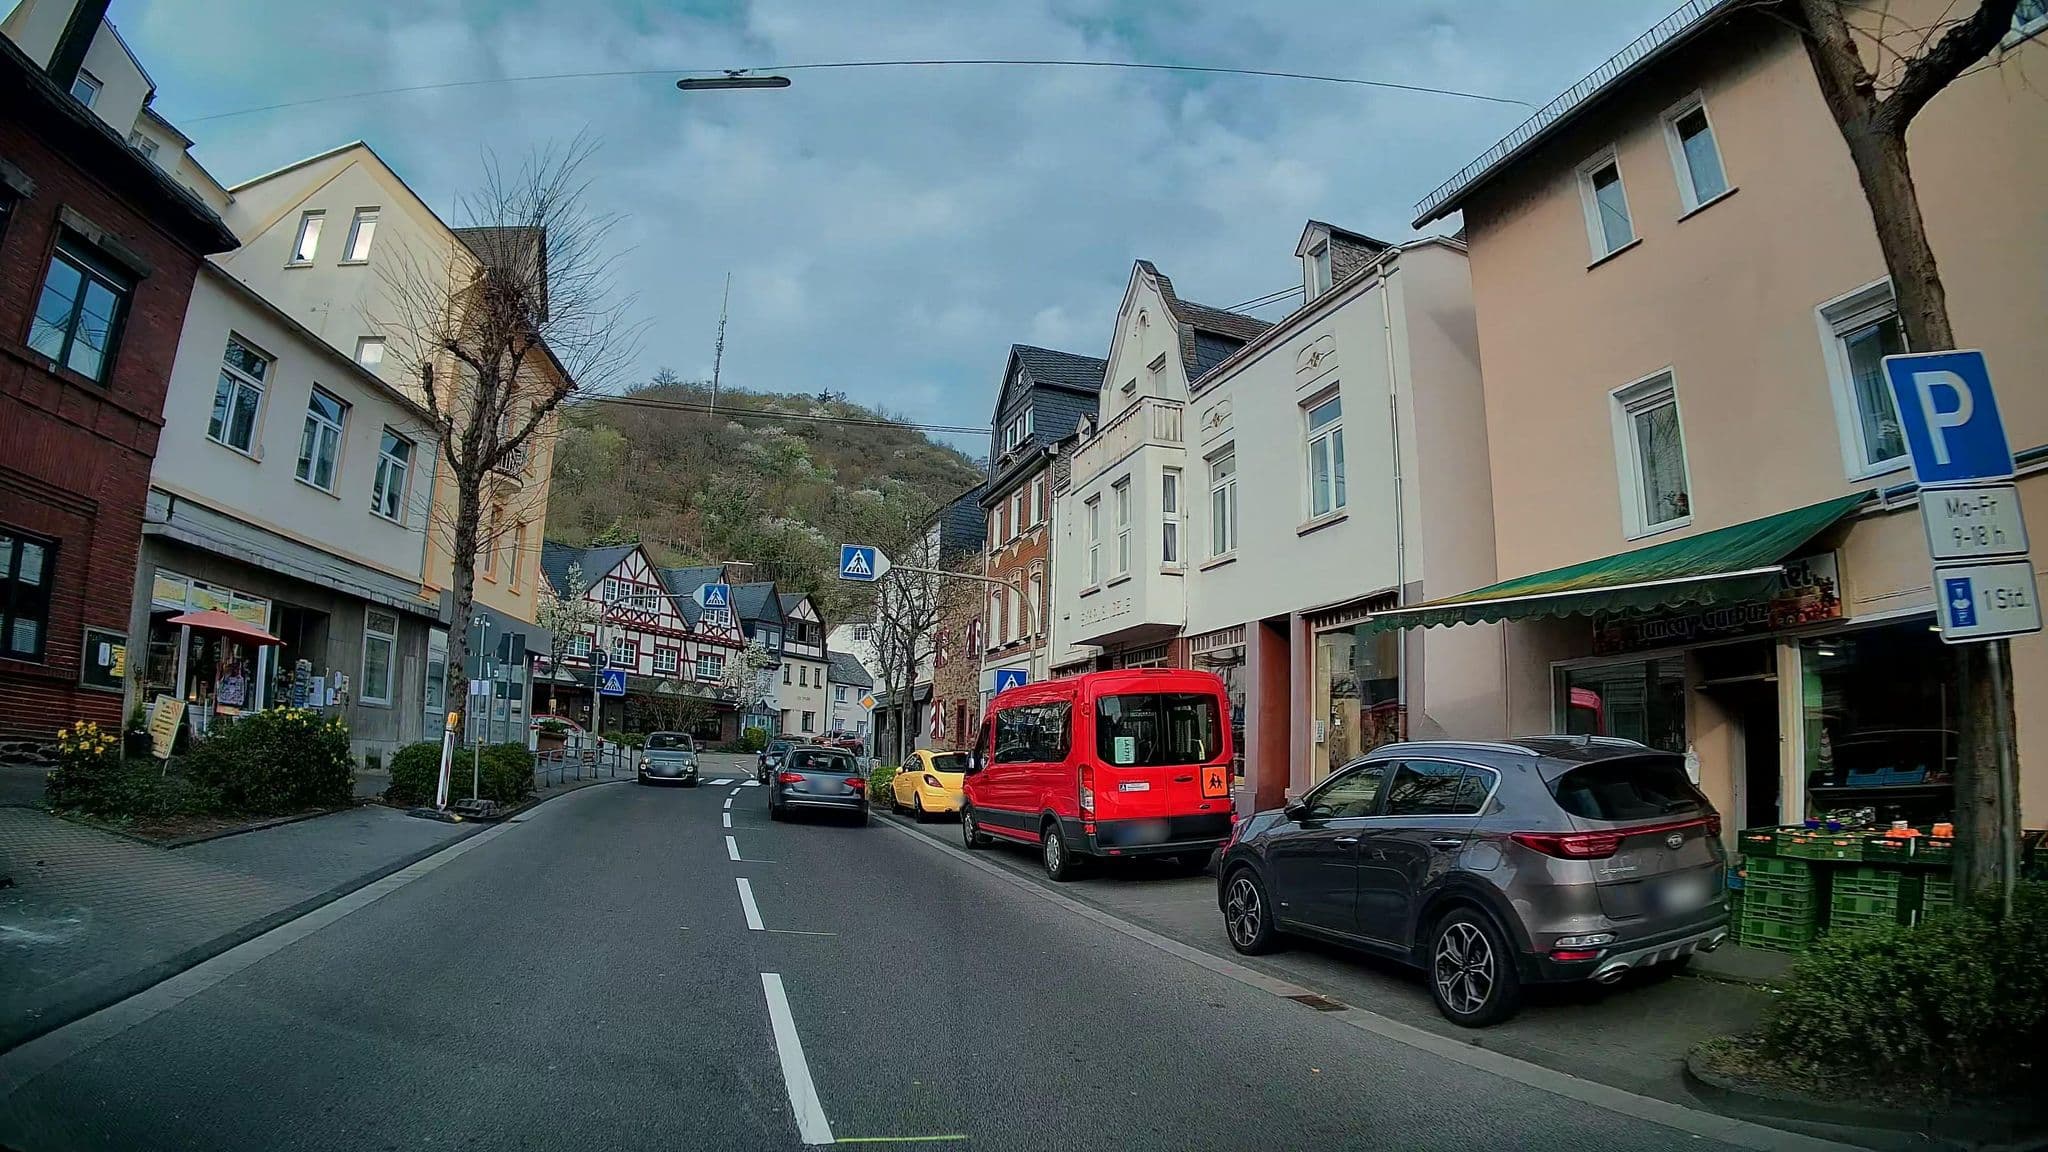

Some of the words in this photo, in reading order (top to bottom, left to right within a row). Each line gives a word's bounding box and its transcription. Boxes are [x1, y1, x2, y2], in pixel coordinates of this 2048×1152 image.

[1912, 371, 1974, 465] P
[1944, 495, 1997, 519] Mo-Fr
[1953, 525, 1989, 548] 9-18
[1994, 524, 2007, 546] h
[1983, 588, 1993, 611] 1
